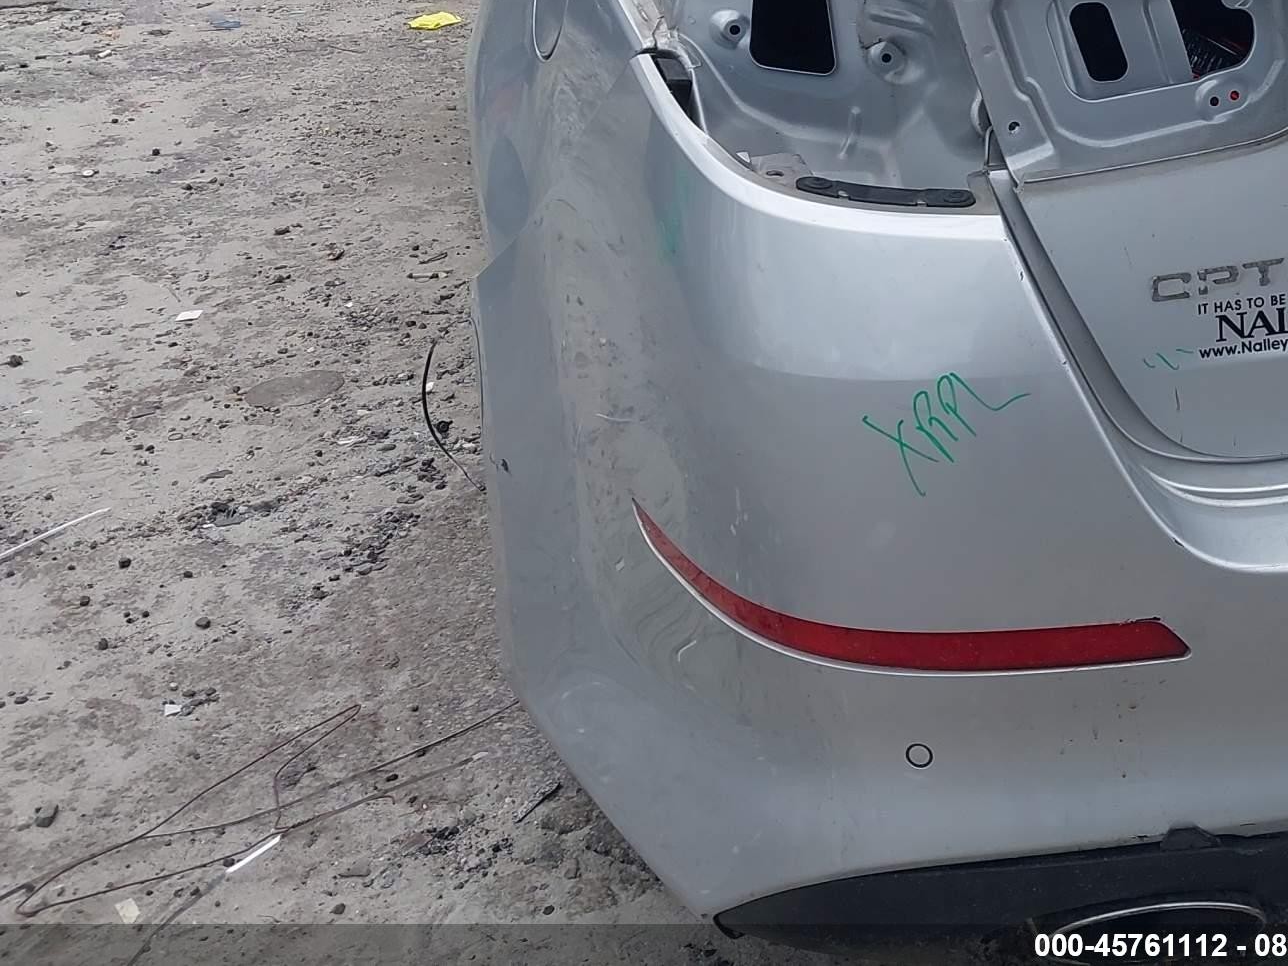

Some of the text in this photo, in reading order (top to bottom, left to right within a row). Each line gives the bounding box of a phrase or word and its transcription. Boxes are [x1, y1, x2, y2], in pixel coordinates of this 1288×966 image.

[1198, 293, 1286, 315] IT HAS TO BE
